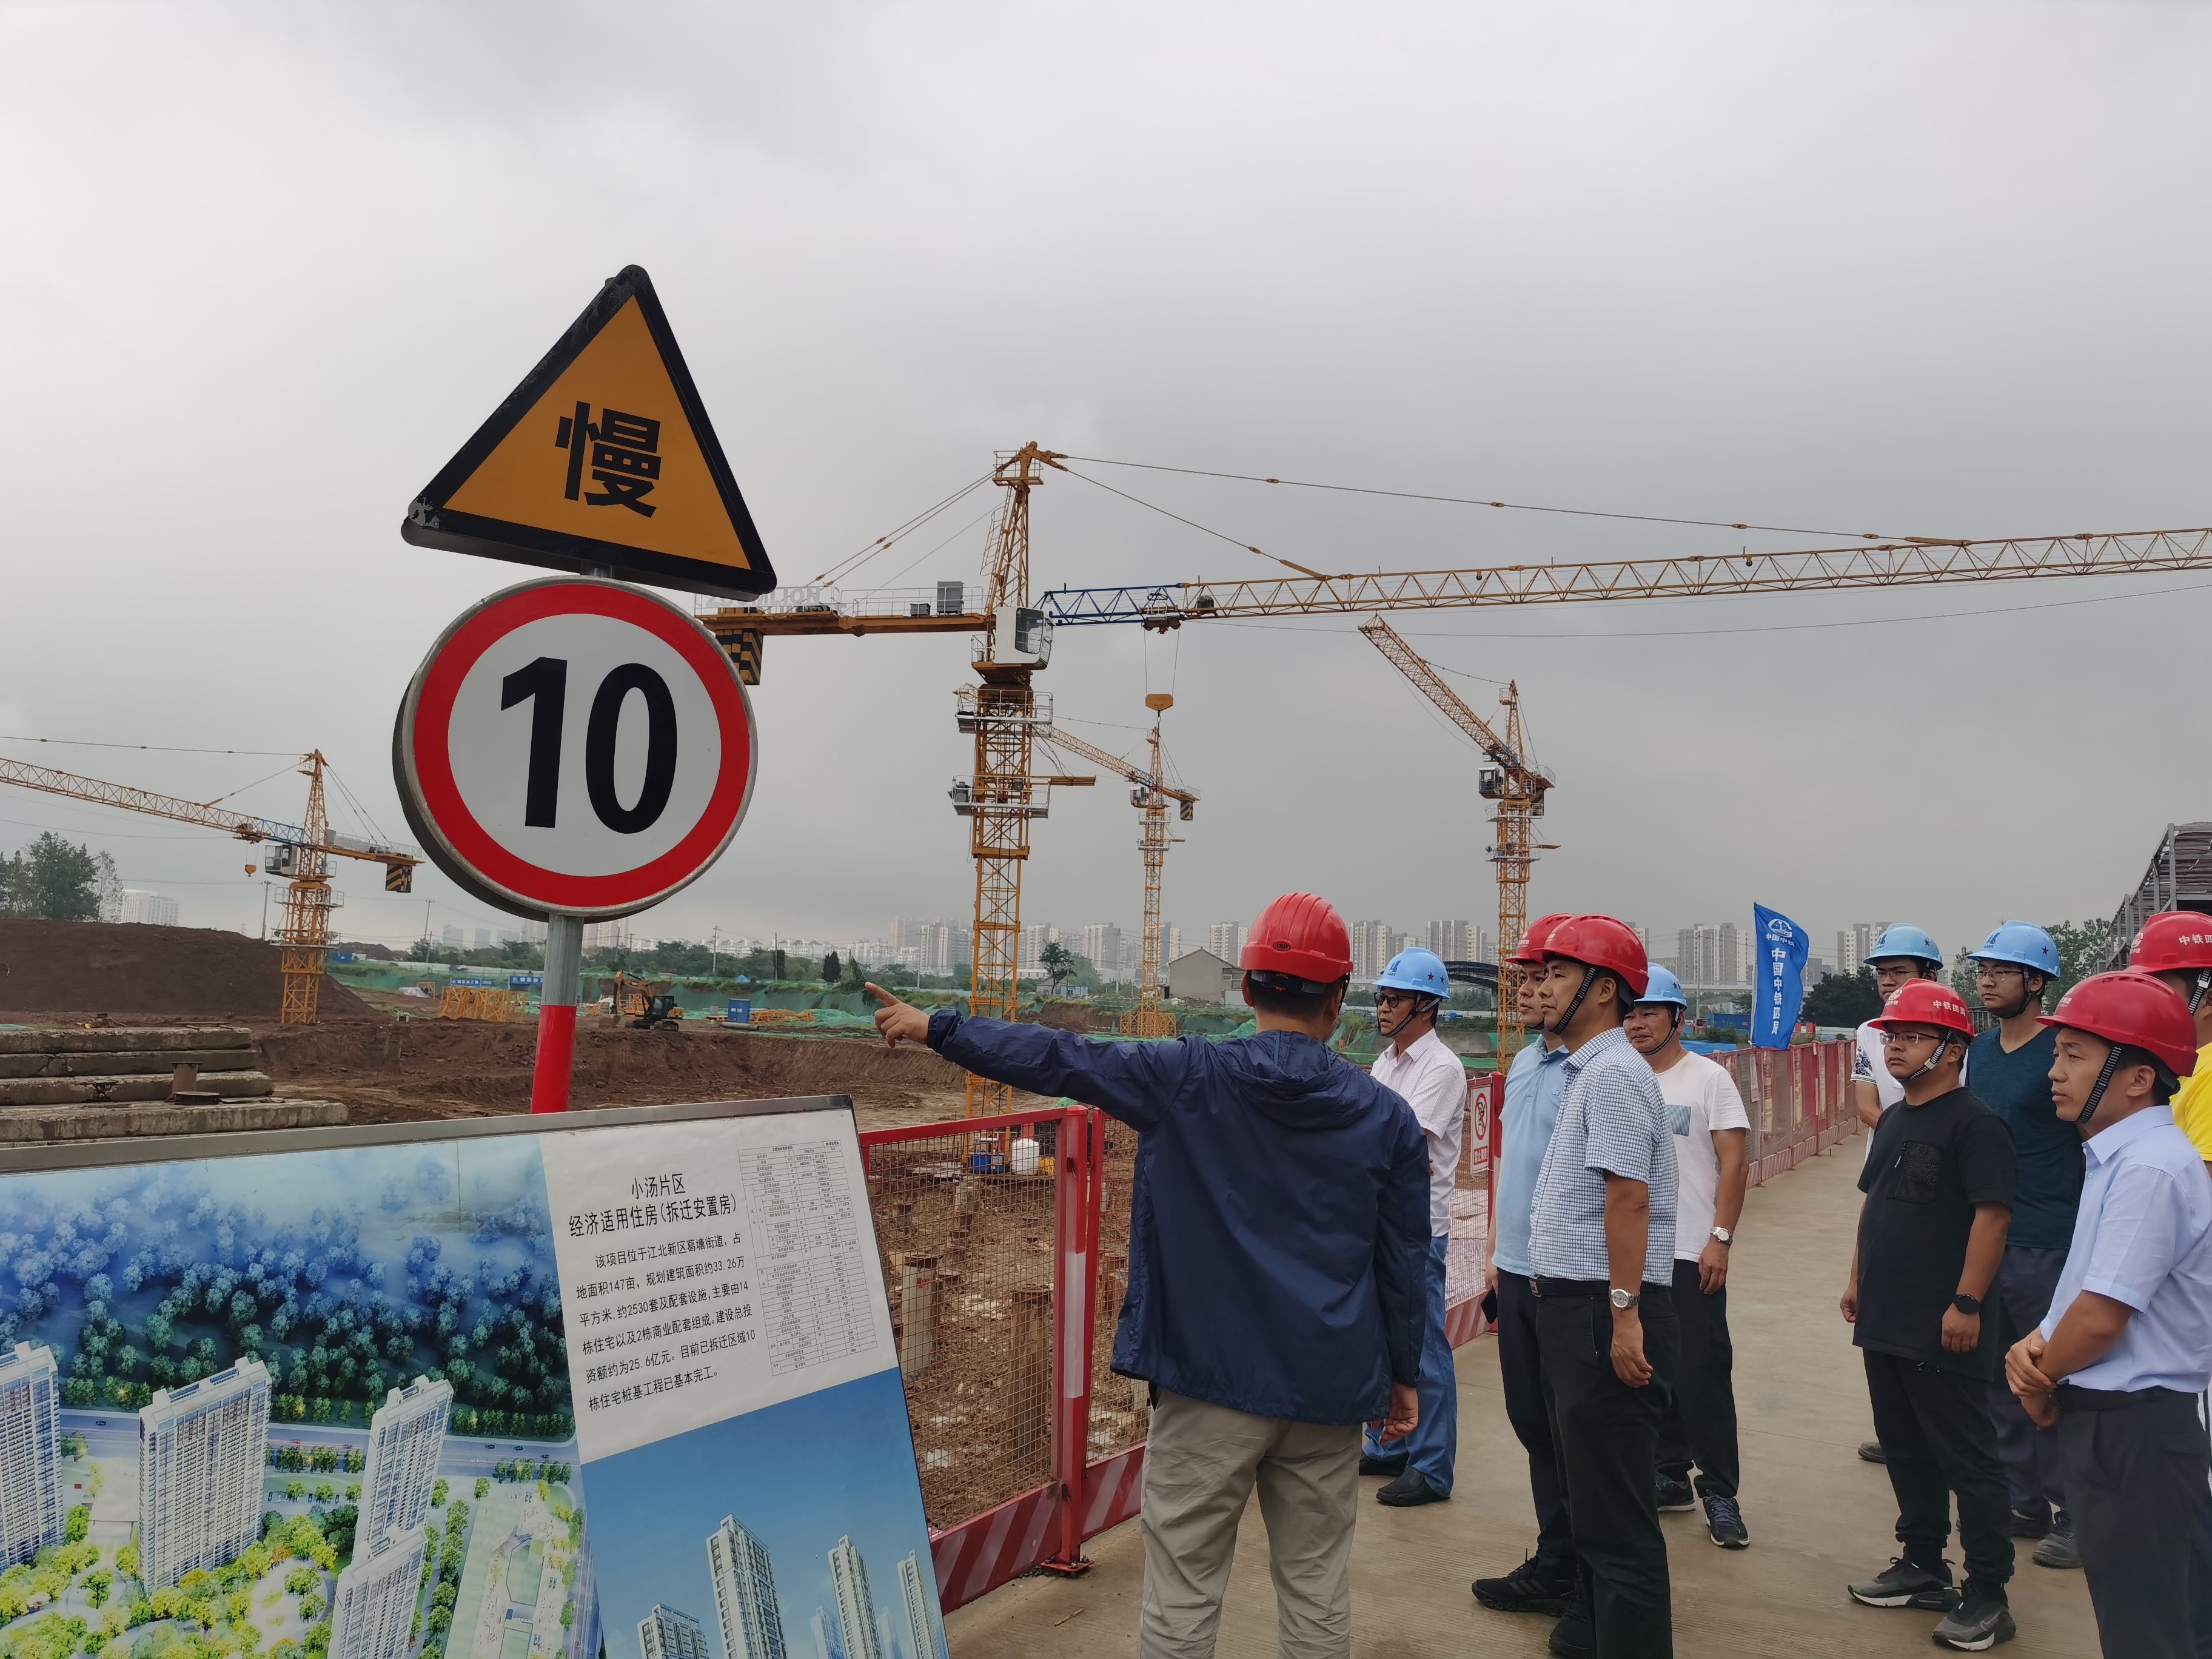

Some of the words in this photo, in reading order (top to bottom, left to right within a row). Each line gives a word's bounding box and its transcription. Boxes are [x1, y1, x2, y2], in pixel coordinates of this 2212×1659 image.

[554, 400, 662, 518] 慢
[500, 656, 677, 834] 10
[1765, 933, 1795, 947] 中国中铁
[1771, 947, 1786, 1034] 中国中铁四局
[1932, 999, 1966, 1017] 中铁四局
[631, 1173, 686, 1199] 小汤片区
[588, 1366, 717, 1412] 栋住宅桩基工程已基本完工。
